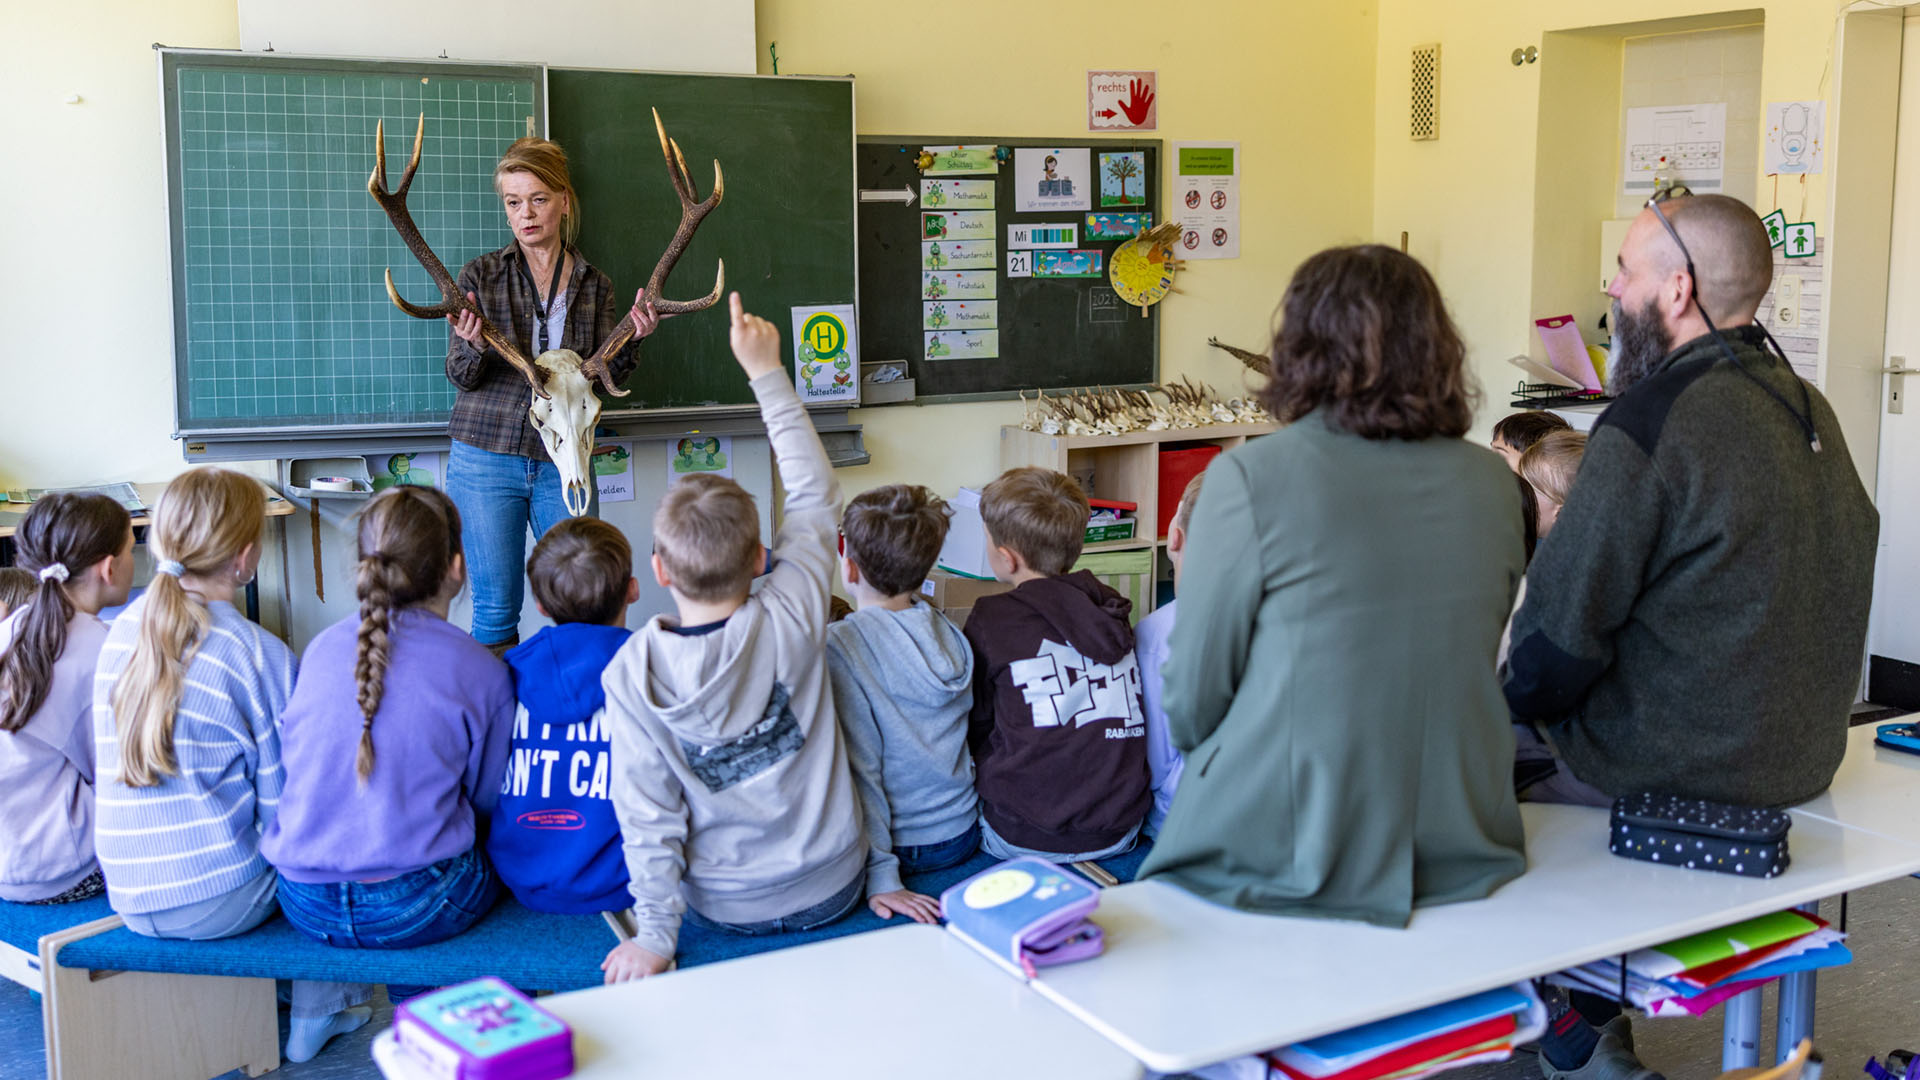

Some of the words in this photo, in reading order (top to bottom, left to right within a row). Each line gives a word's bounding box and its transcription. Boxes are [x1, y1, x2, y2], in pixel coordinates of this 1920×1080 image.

[1097, 82, 1127, 93] rechts
[953, 192, 988, 200] Mathematik
[960, 221, 984, 230] Deutsch
[1015, 231, 1028, 242] Mi
[951, 251, 993, 259] Sachunterricht
[1010, 257, 1029, 273] 21.
[958, 281, 985, 289] Frühstück
[956, 312, 990, 320] Mathematik
[816, 326, 832, 349] H
[966, 340, 983, 349] Sport
[807, 387, 846, 397] Haltestelle
[568, 749, 613, 800] CA
